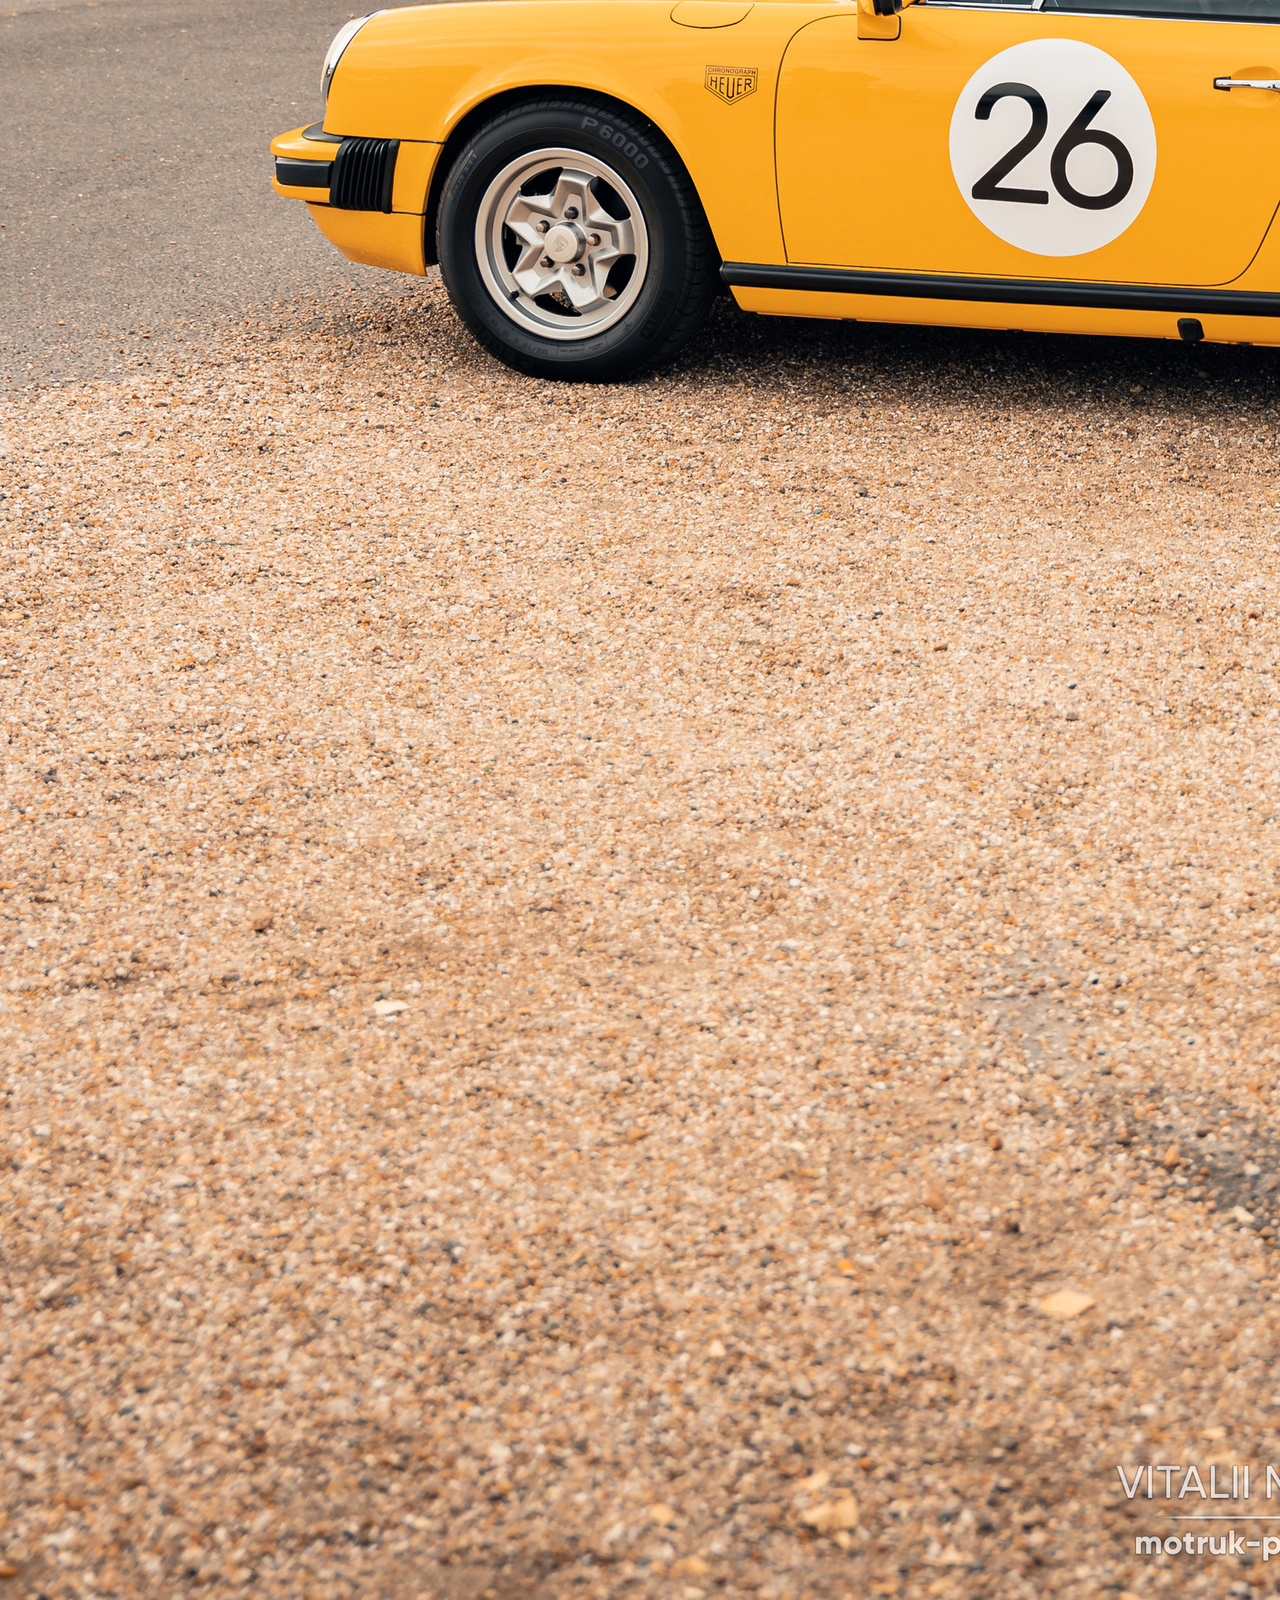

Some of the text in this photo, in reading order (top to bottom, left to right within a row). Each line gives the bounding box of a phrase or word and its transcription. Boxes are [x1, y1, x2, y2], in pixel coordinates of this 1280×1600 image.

[707, 67, 757, 75] CHRONOGRAPH
[710, 76, 752, 99] HEUER
[971, 81, 1134, 211] 26
